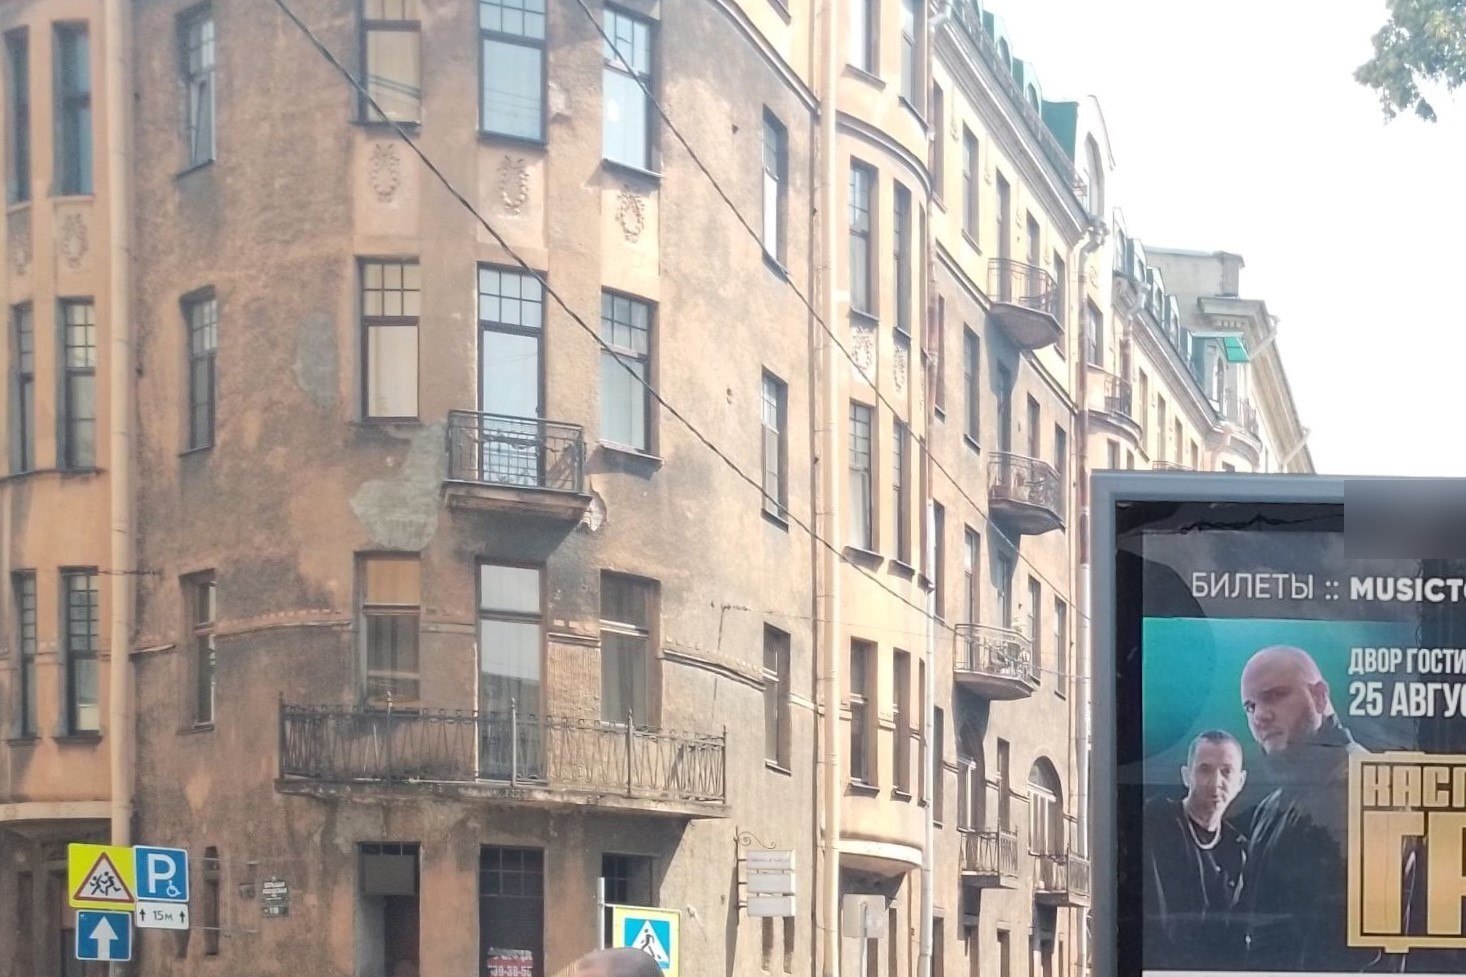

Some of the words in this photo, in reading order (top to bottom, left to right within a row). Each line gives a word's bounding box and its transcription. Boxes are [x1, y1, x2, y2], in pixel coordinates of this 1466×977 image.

[1191, 572, 1314, 599] БИЛЕТЫ
[1348, 648, 1402, 676] ДВОР
[1349, 681, 1384, 717] 25
[148, 853, 176, 893] P
